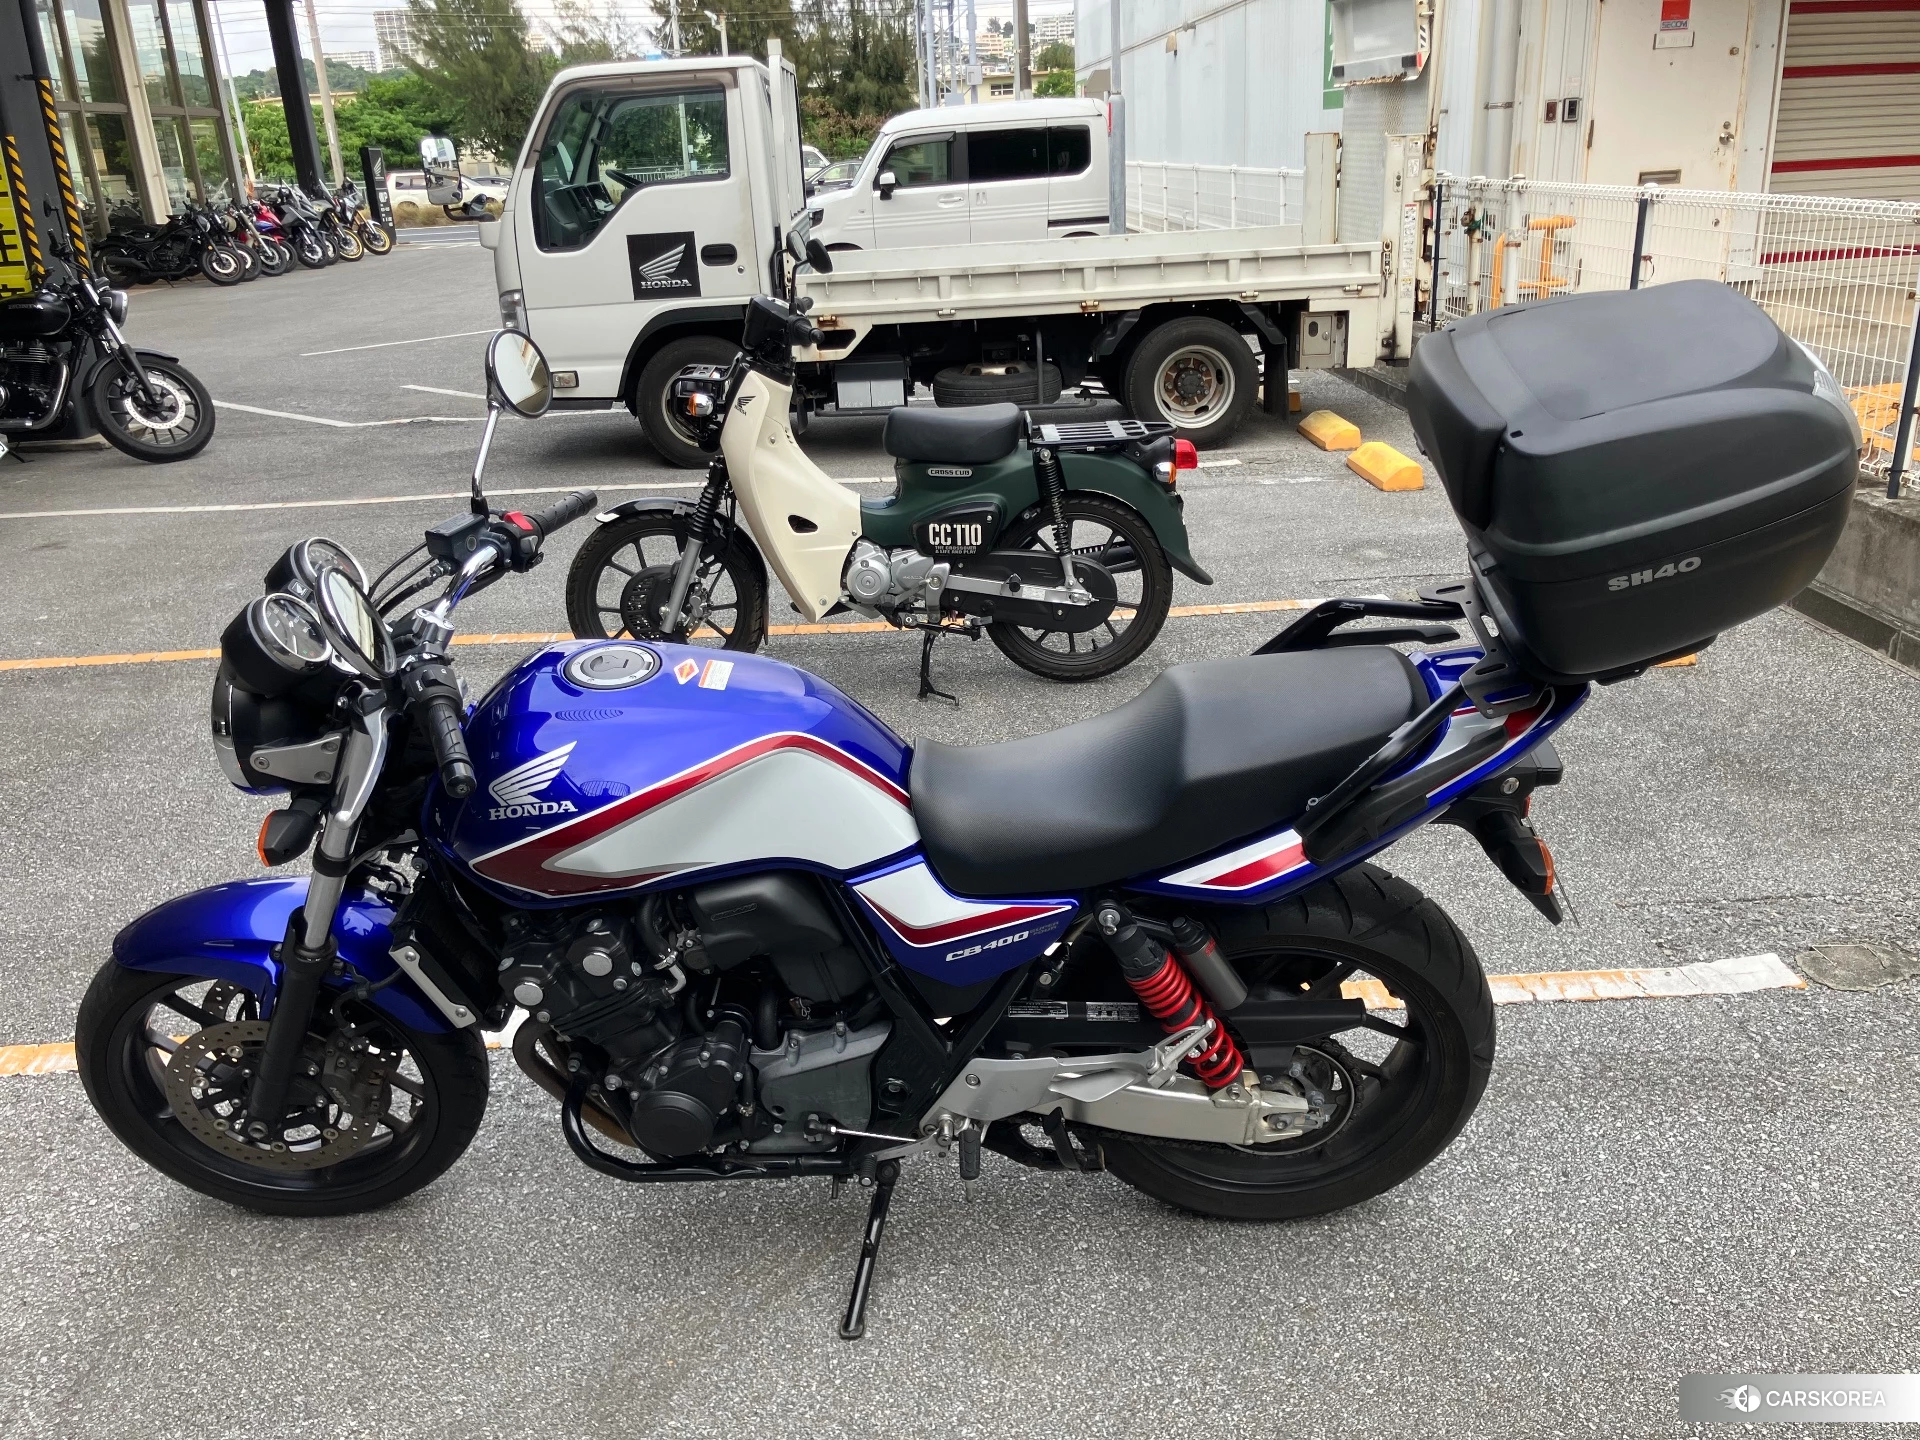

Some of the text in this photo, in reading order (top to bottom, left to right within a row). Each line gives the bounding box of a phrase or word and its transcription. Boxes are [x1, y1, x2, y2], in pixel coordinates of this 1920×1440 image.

[640, 279, 692, 289] HONDA
[1607, 556, 1702, 592] SH40
[488, 800, 579, 821] HONDA
[945, 930, 1030, 962] CB400
